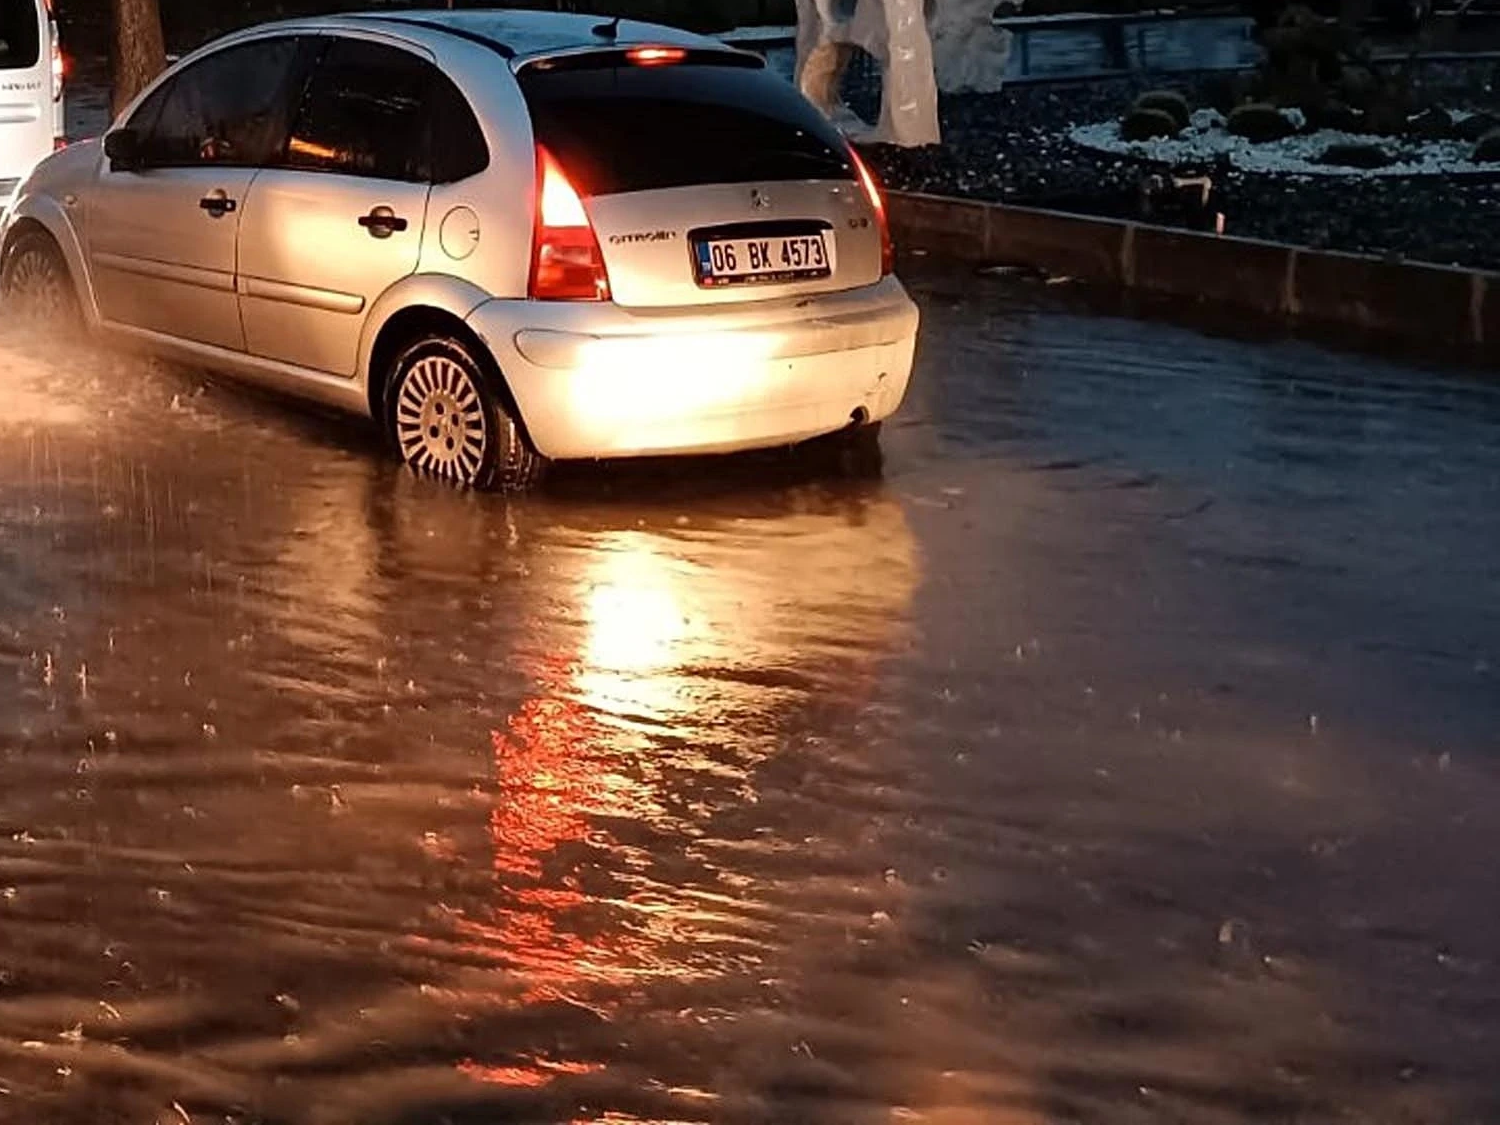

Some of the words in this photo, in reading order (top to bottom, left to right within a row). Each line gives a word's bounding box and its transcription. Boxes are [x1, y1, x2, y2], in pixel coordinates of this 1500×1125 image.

[712, 244, 737, 271] 06
[747, 242, 772, 269] BK
[781, 238, 823, 267] 4573
